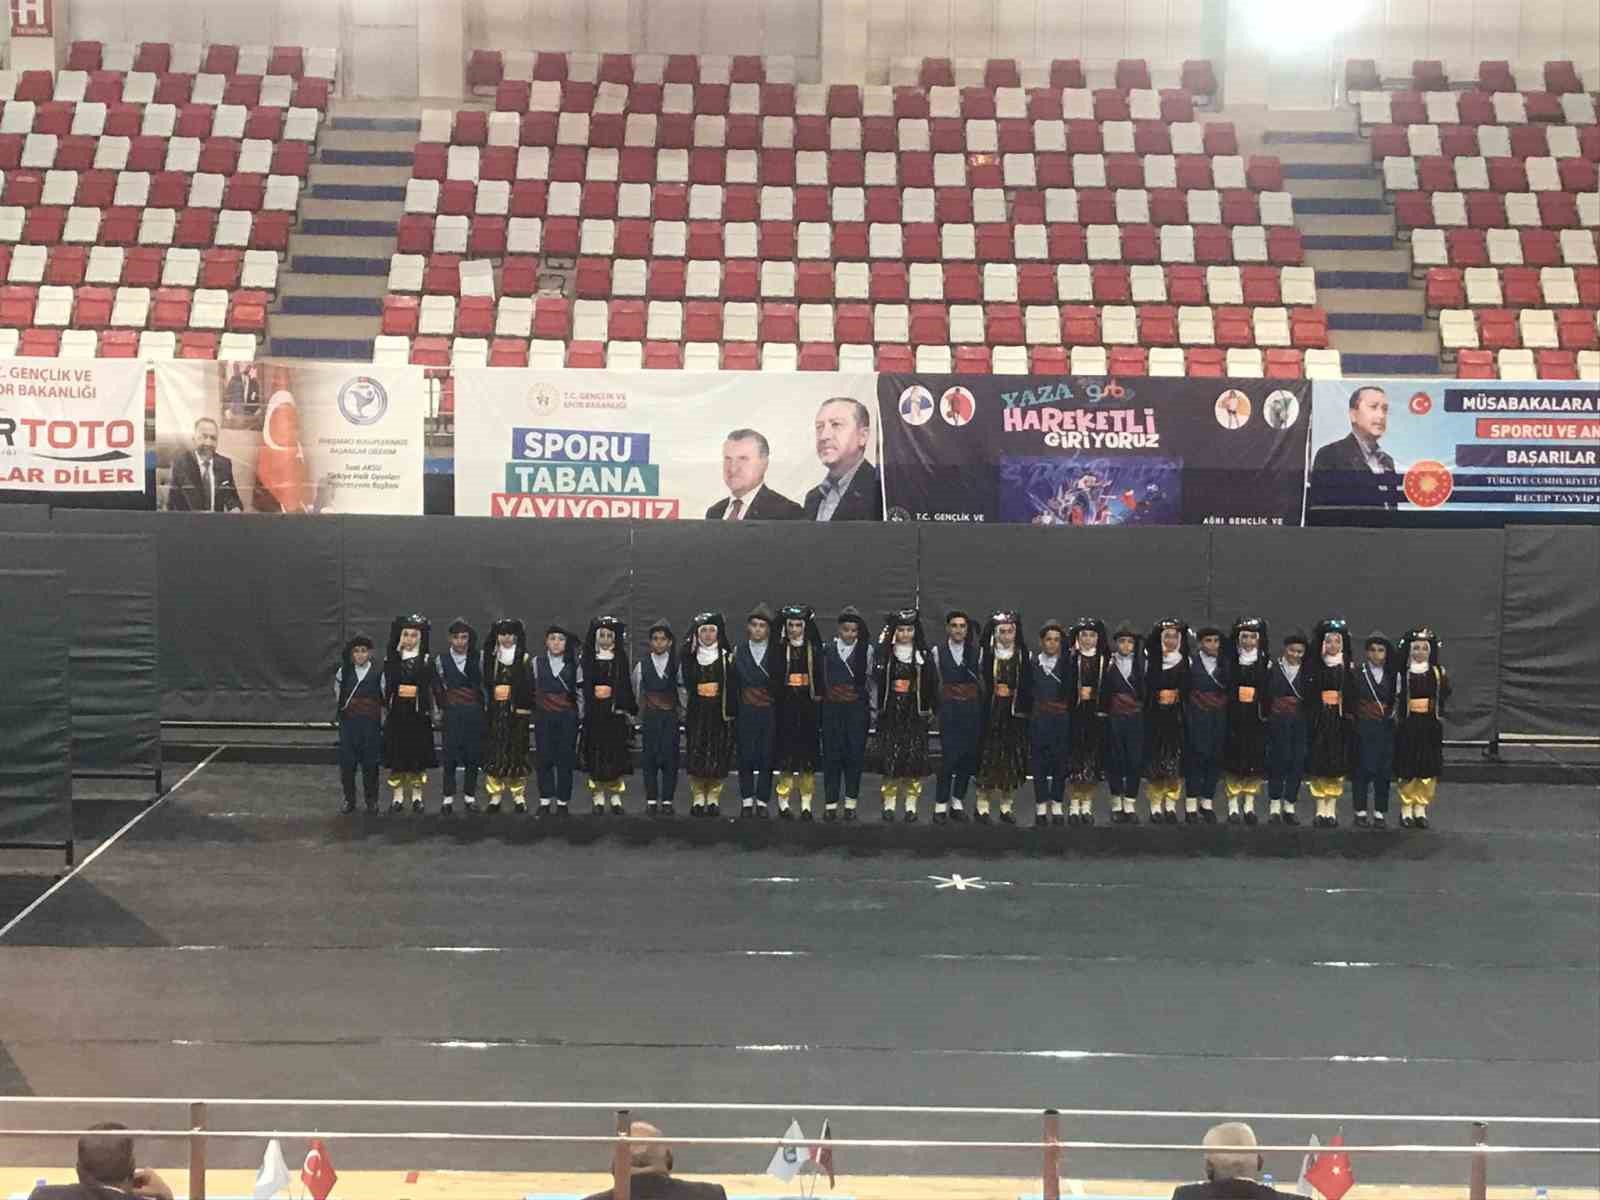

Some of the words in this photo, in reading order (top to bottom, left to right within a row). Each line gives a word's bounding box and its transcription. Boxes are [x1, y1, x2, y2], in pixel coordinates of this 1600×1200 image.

[10, 366, 71, 382] GENÇLİK
[75, 370, 92, 382] VE
[18, 382, 97, 399] BAKANLIĞI
[1001, 383, 1074, 408] YAZA
[1463, 393, 1593, 411] MÜSABAKALARA
[1490, 424, 1553, 438] SPORCU
[1556, 424, 1577, 438] VE
[523, 431, 632, 462] SPORU
[1044, 431, 1161, 449] GİRİYORUZ
[1506, 449, 1596, 466] BAŞARILAR
[54, 465, 135, 484] DİLER
[515, 466, 646, 493] TABANA
[1514, 493, 1551, 502] RECEP
[1553, 493, 1594, 503] TAYYİP
[916, 512, 931, 521] T.C.
[934, 511, 970, 522] GENÇLİK
[973, 513, 985, 522] VE
